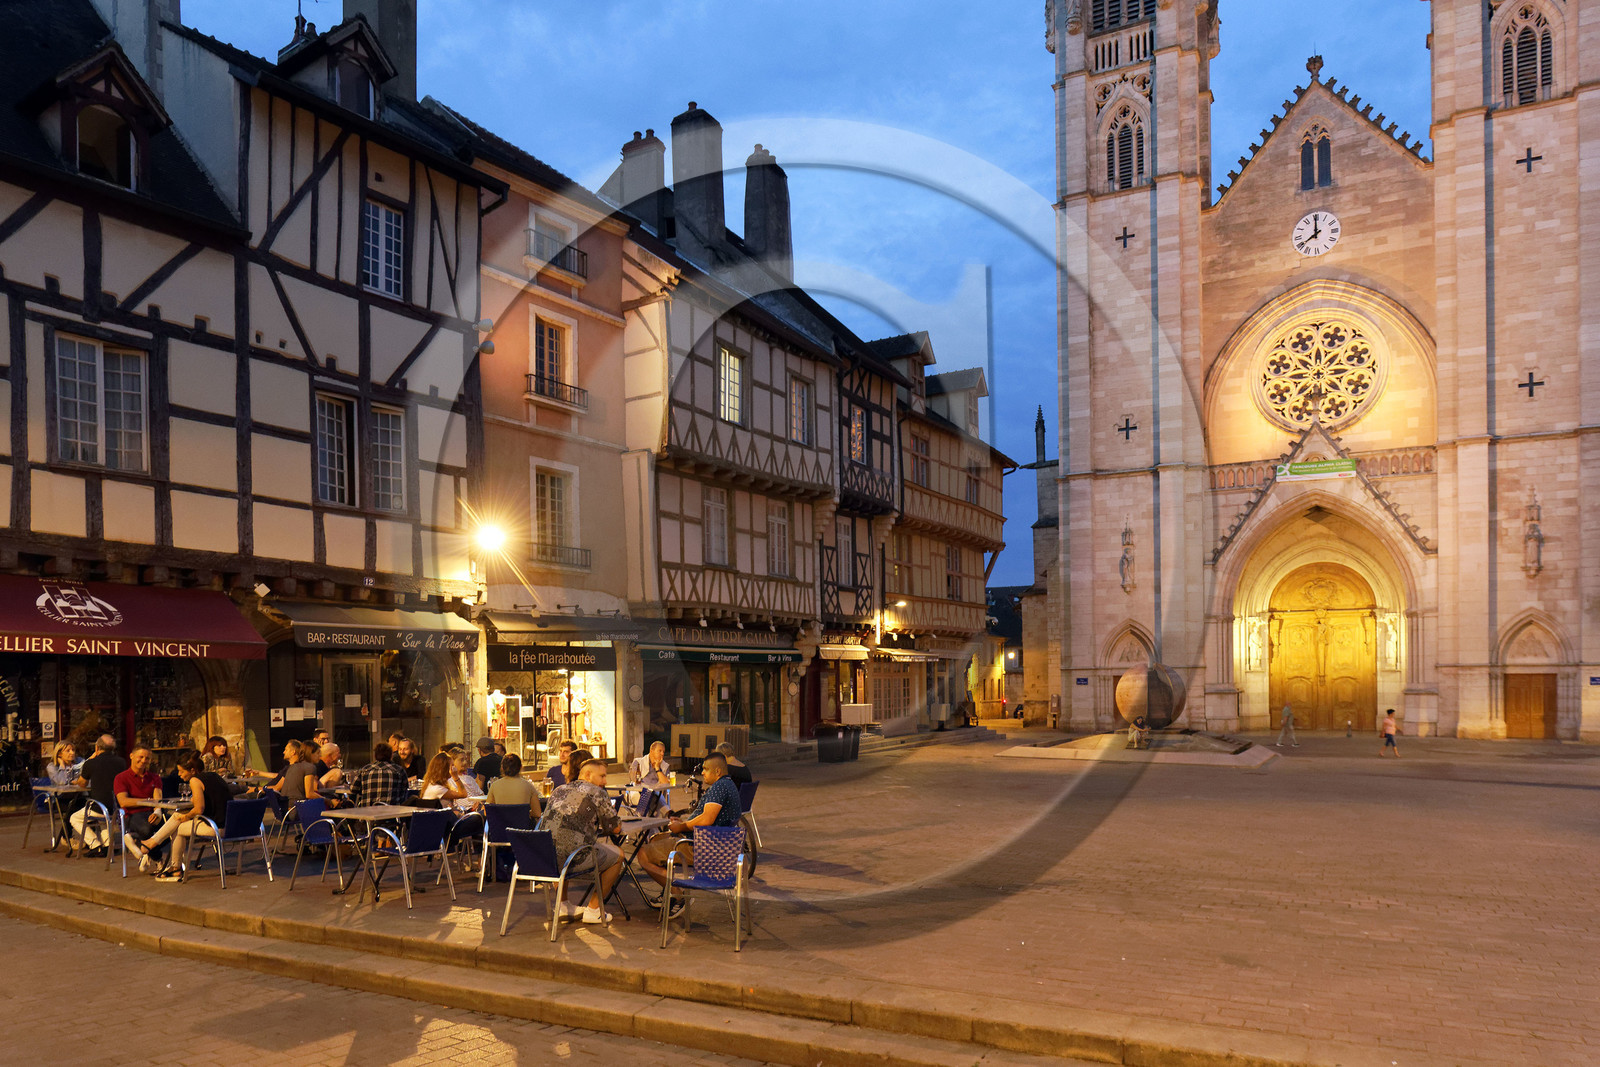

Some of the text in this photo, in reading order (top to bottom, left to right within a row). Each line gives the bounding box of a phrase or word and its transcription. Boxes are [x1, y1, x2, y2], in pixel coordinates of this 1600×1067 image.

[365, 577, 374, 586] 12
[307, 632, 386, 646] BAR RESTAURANT
[425, 633, 435, 649] la
[691, 629, 705, 642] DU
[709, 630, 742, 644] VERRE
[745, 631, 779, 646] GALANT
[66, 639, 122, 654] SAINT
[134, 641, 211, 658] VINCENT
[509, 649, 596, 670] la fée maraboutée
[709, 653, 740, 662] Restaurant
[767, 654, 777, 662] Bar
[782, 654, 793, 662] Vins
[0, 675, 20, 707] CENT
[0, 781, 21, 793] nt.fr
